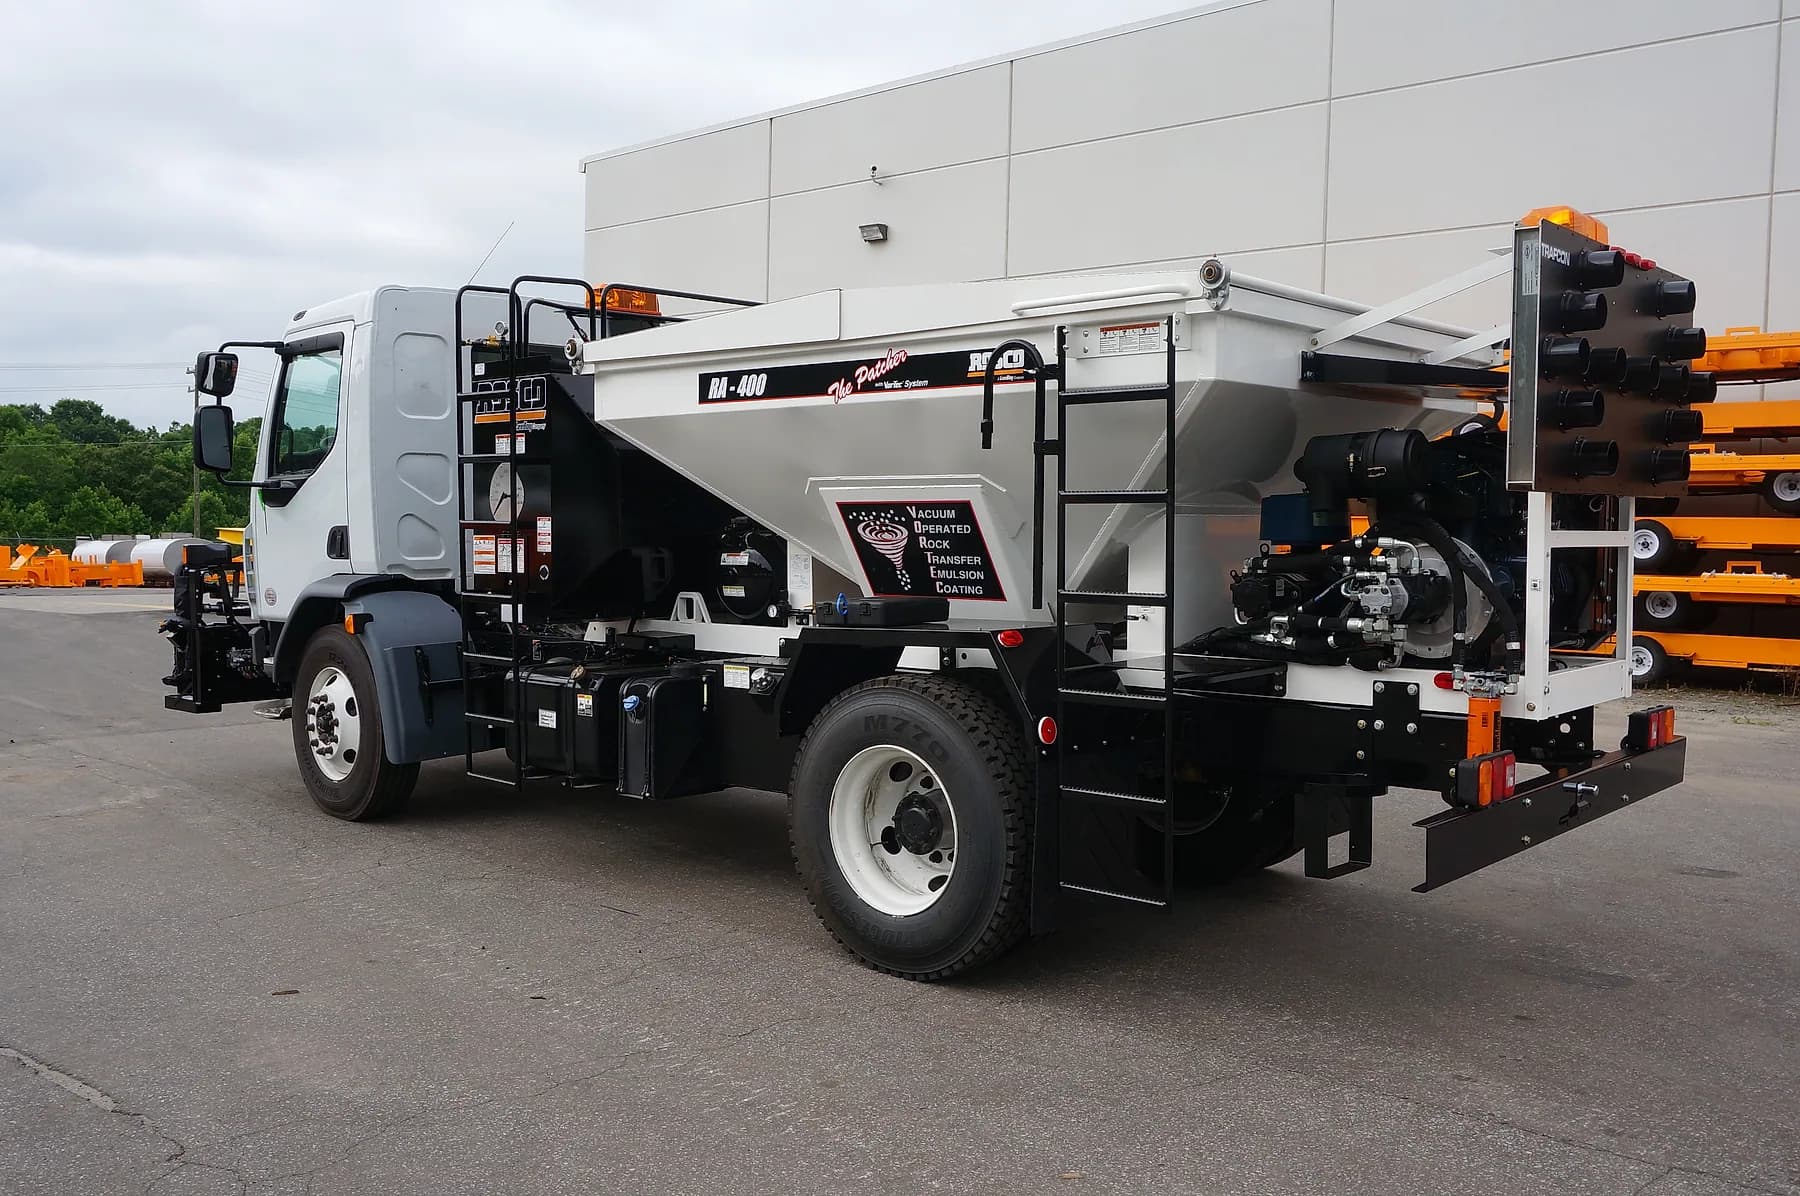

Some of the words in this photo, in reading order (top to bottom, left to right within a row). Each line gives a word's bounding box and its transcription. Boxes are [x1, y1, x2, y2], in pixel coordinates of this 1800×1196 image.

[1542, 242, 1571, 266] TRAFCON
[827, 377, 853, 404] The
[854, 347, 908, 390] Patcher
[906, 505, 956, 519] VACUUM
[914, 520, 971, 535] OPERATED
[919, 536, 950, 549] ROCK
[924, 551, 982, 565] TRANSFER
[930, 565, 984, 580] EMULSION
[935, 581, 983, 595] COATING
[864, 714, 950, 762] M770
